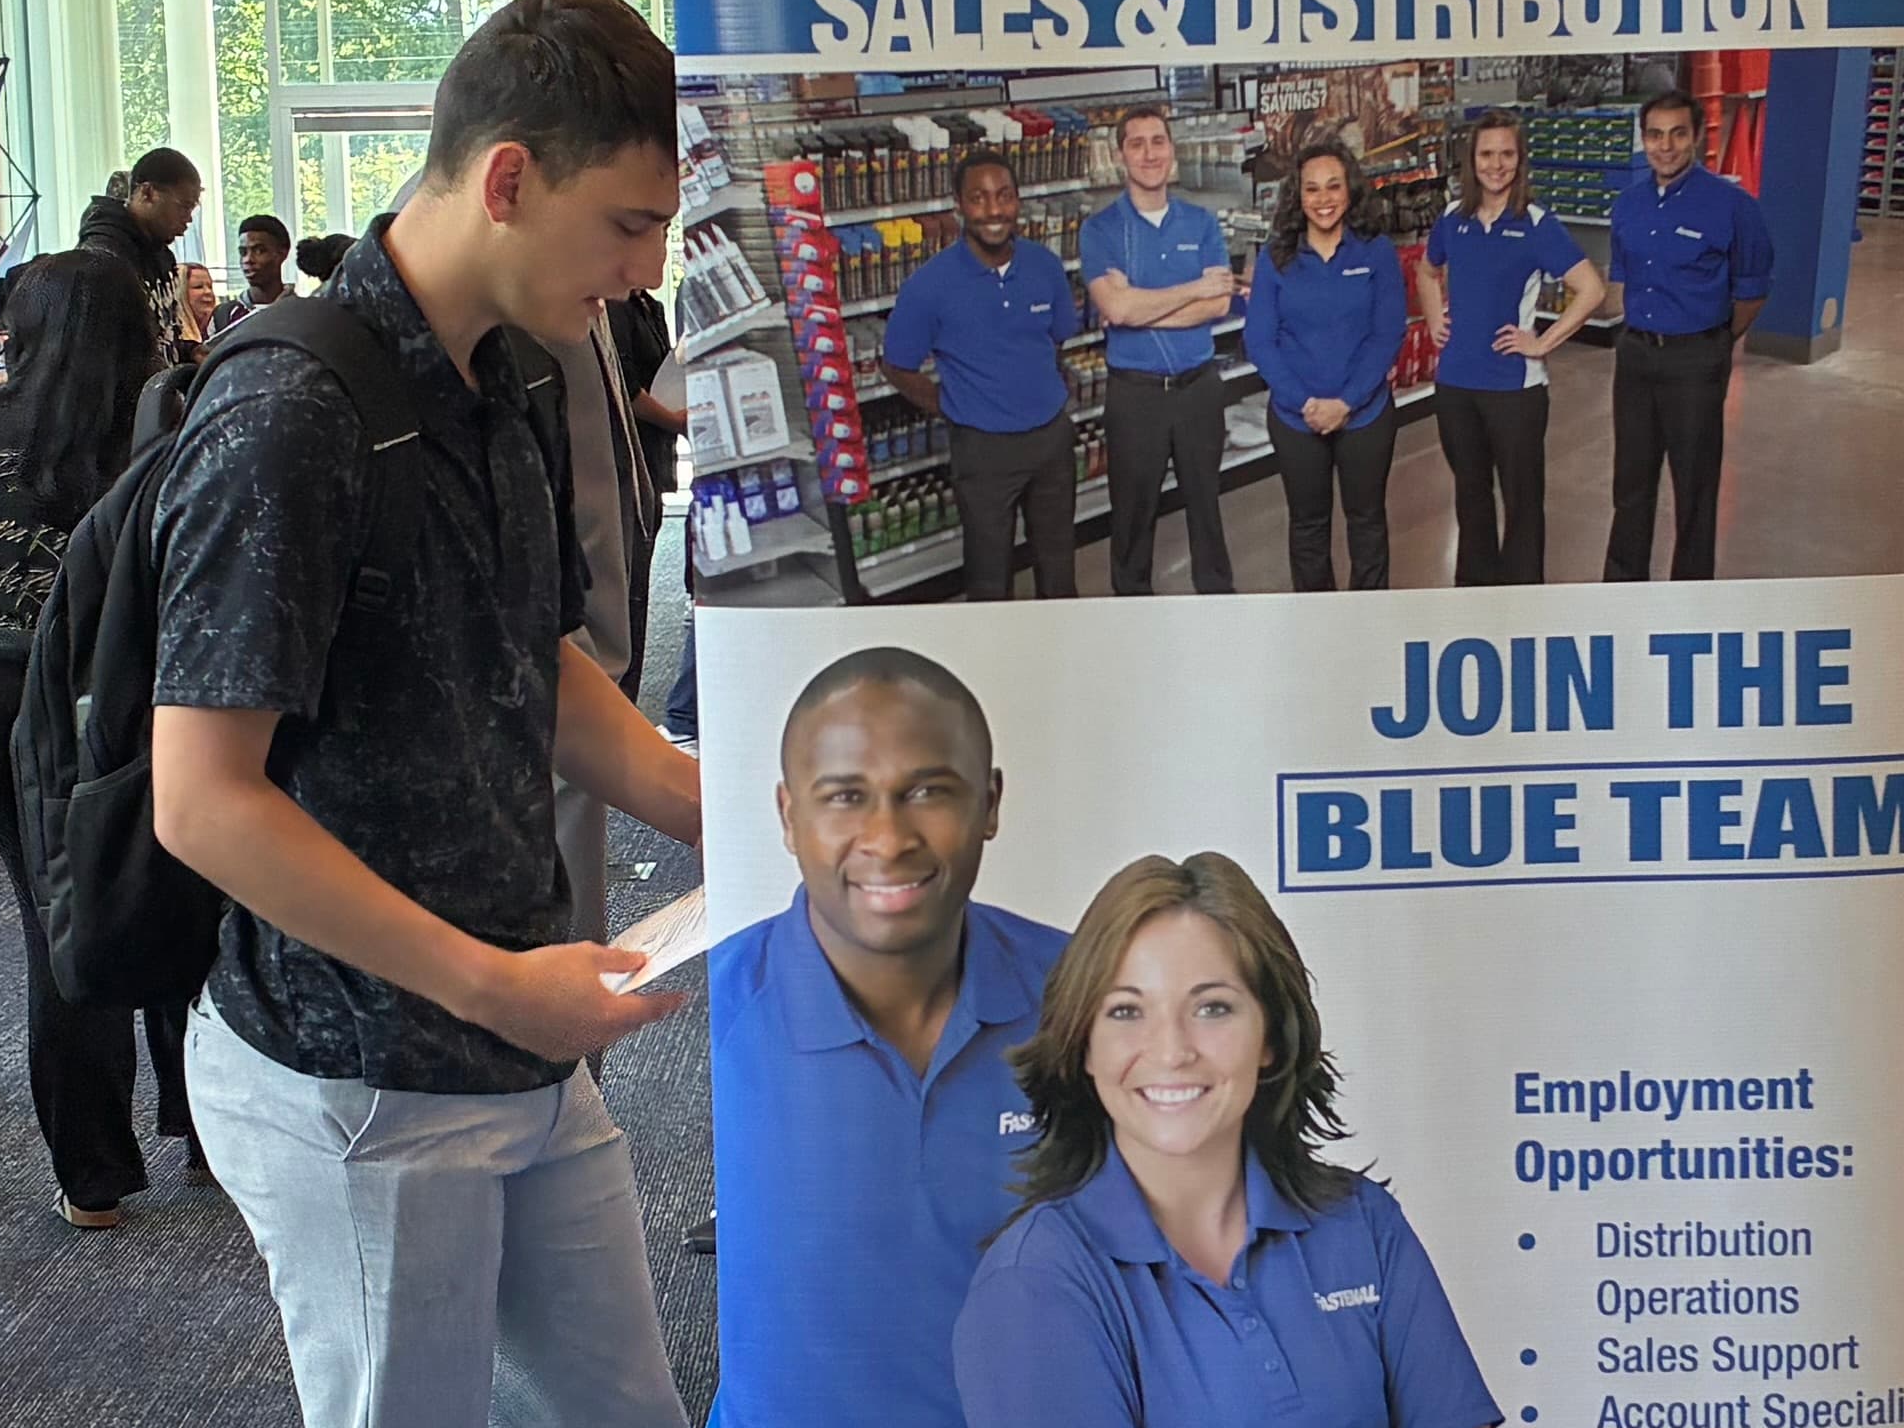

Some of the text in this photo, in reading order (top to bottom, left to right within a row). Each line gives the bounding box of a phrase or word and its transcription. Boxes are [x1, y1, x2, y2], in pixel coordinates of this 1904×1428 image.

[1260, 90, 1328, 114] SAVINGS?
[1370, 629, 1853, 739] JOIN THE
[1296, 783, 1580, 872] BLUE
[1514, 1068, 1815, 1122] Employment
[1514, 1136, 1854, 1191] Opportunities:
[1596, 1220, 1813, 1259] Distribution
[1597, 1279, 1800, 1323] Operations
[1597, 1334, 1860, 1380] Sales Support
